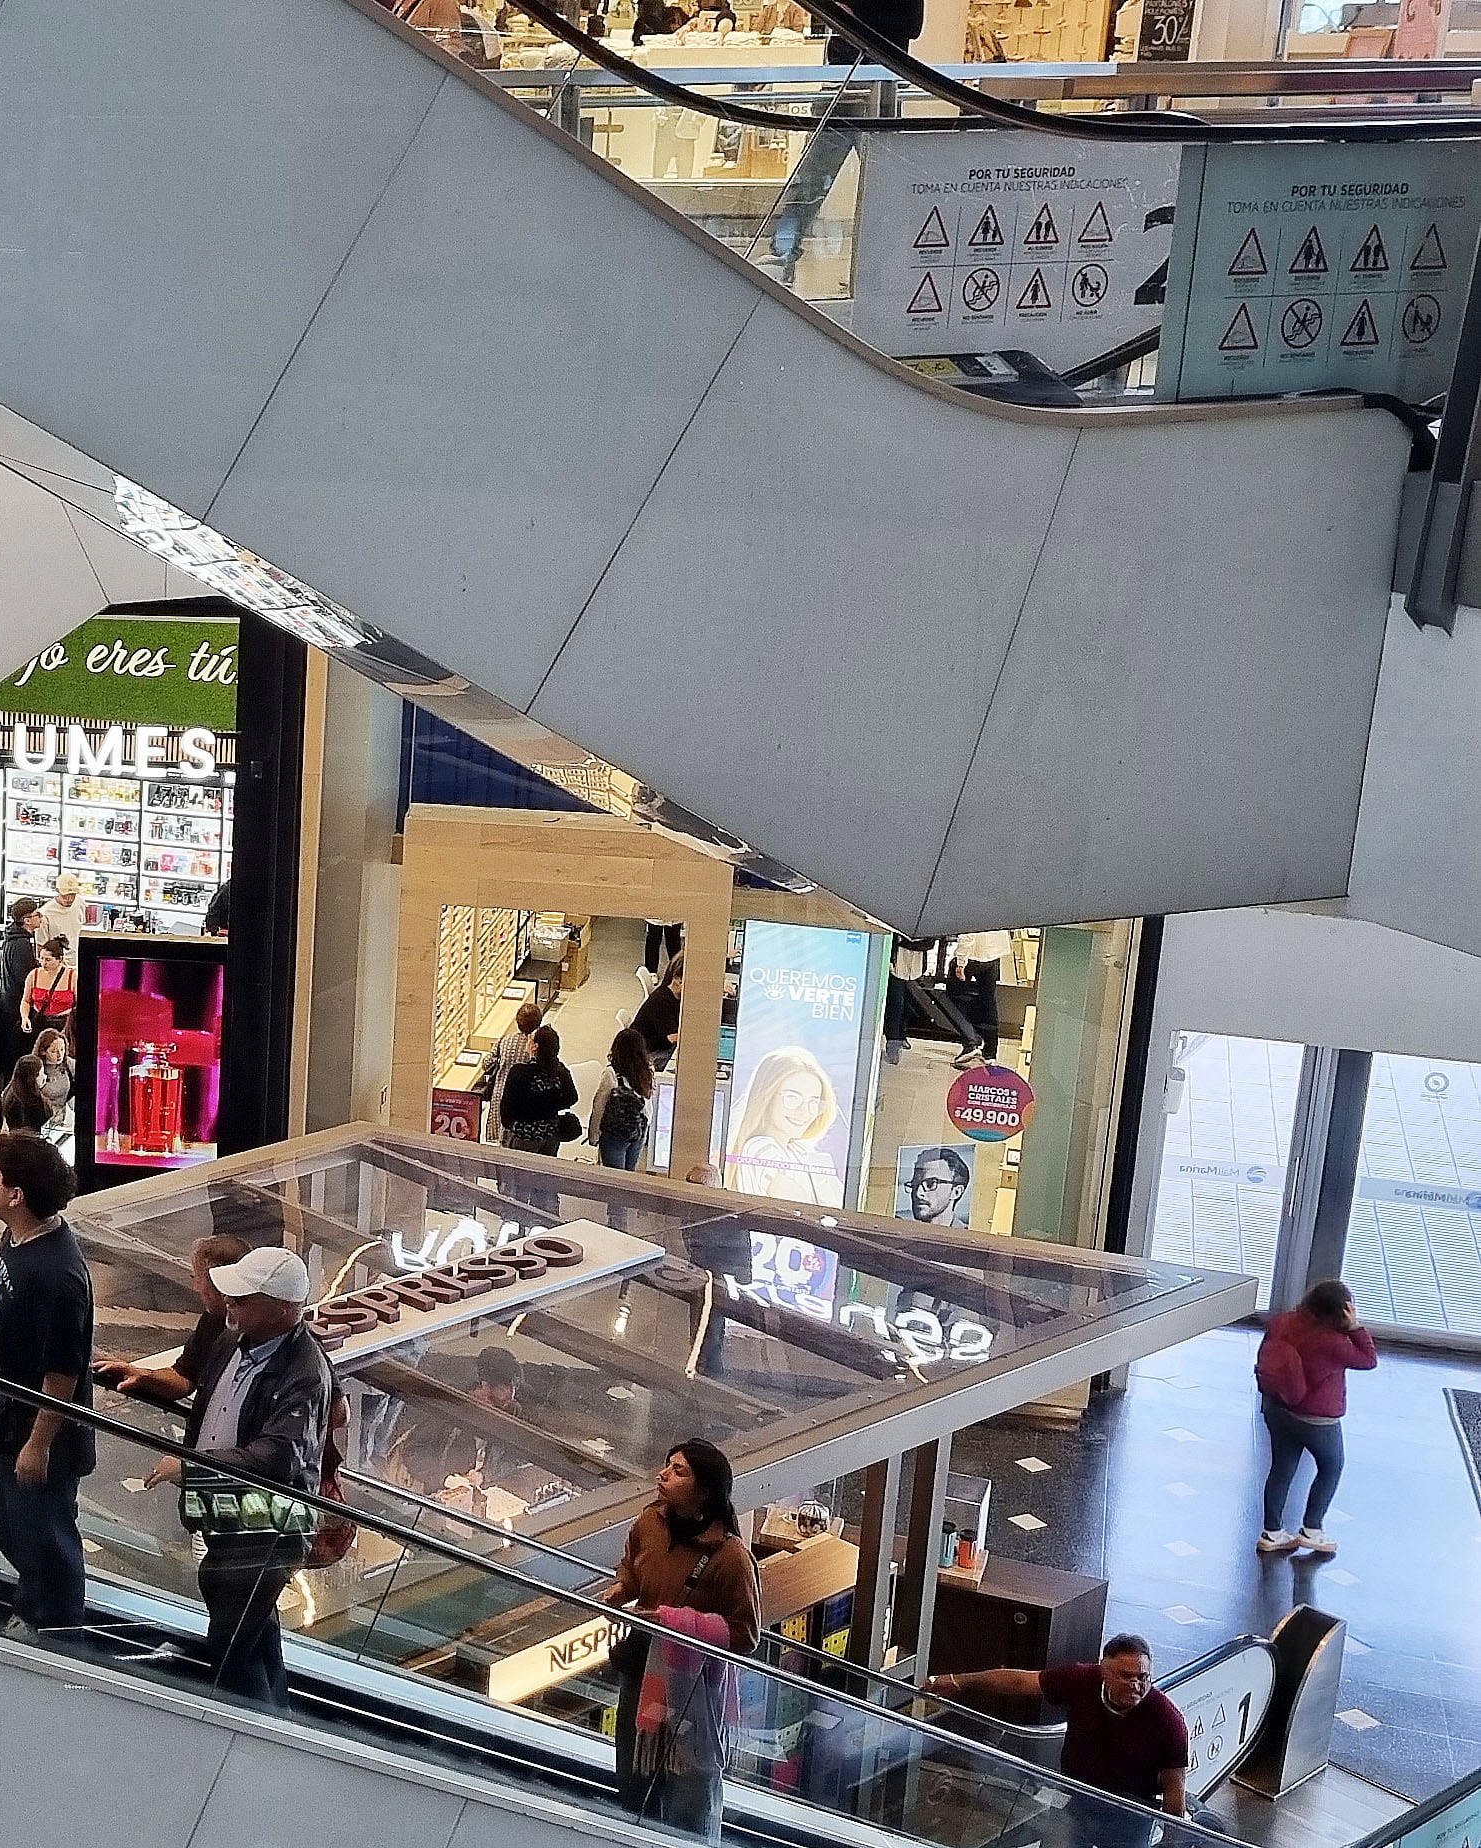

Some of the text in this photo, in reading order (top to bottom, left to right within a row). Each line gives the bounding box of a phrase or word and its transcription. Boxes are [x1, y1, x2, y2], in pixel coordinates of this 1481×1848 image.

[968, 166, 1076, 181] POR TU SEGURIDAD
[912, 183, 941, 194] TOMA
[943, 183, 958, 194] EN
[960, 181, 1001, 193] CUENTA
[1003, 179, 1057, 192] NUESTRAS
[1291, 182, 1409, 197] POR TU SEGURIDAD
[1227, 201, 1259, 213] TOMA
[1262, 200, 1279, 213] EN
[1281, 199, 1326, 212] CUENTA
[86, 639, 176, 678] eres
[750, 967, 857, 992] QUEREMOS
[787, 983, 855, 1007] VERTE
[812, 1003, 854, 1022] BIEN
[968, 1085, 1010, 1096] MARCOS
[968, 1093, 1018, 1104] CRISTALES
[303, 1236, 584, 1351] ESPRESSO
[1237, 1691, 1252, 1746] 1
